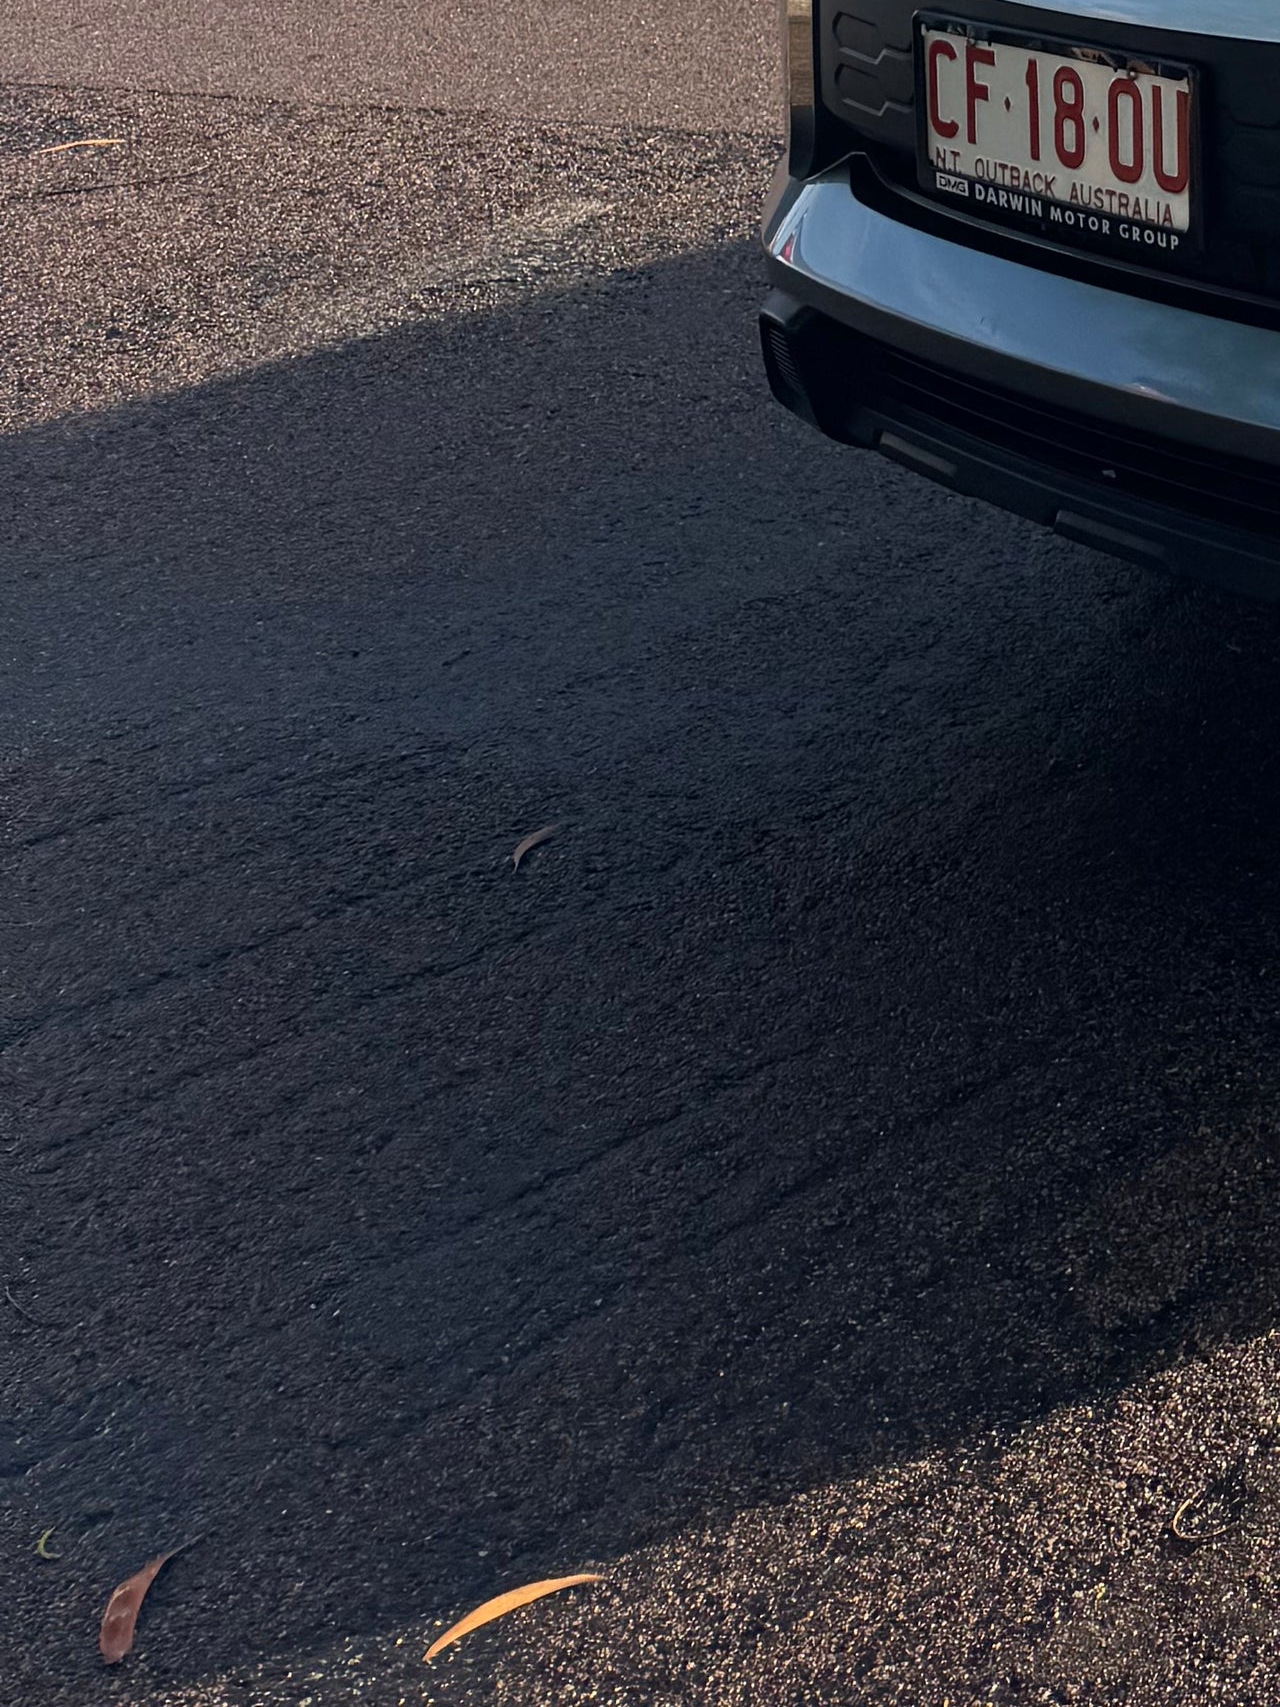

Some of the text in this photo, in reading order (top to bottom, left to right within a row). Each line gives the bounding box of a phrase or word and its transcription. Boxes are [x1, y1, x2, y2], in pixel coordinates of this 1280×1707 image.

[974, 157, 1056, 200] OUTBACK
[1069, 182, 1174, 228] AUSTRALIA
[974, 183, 1043, 218] DARWIN
[1050, 205, 1110, 235] MOTOR
[1119, 223, 1179, 251] GROUP
